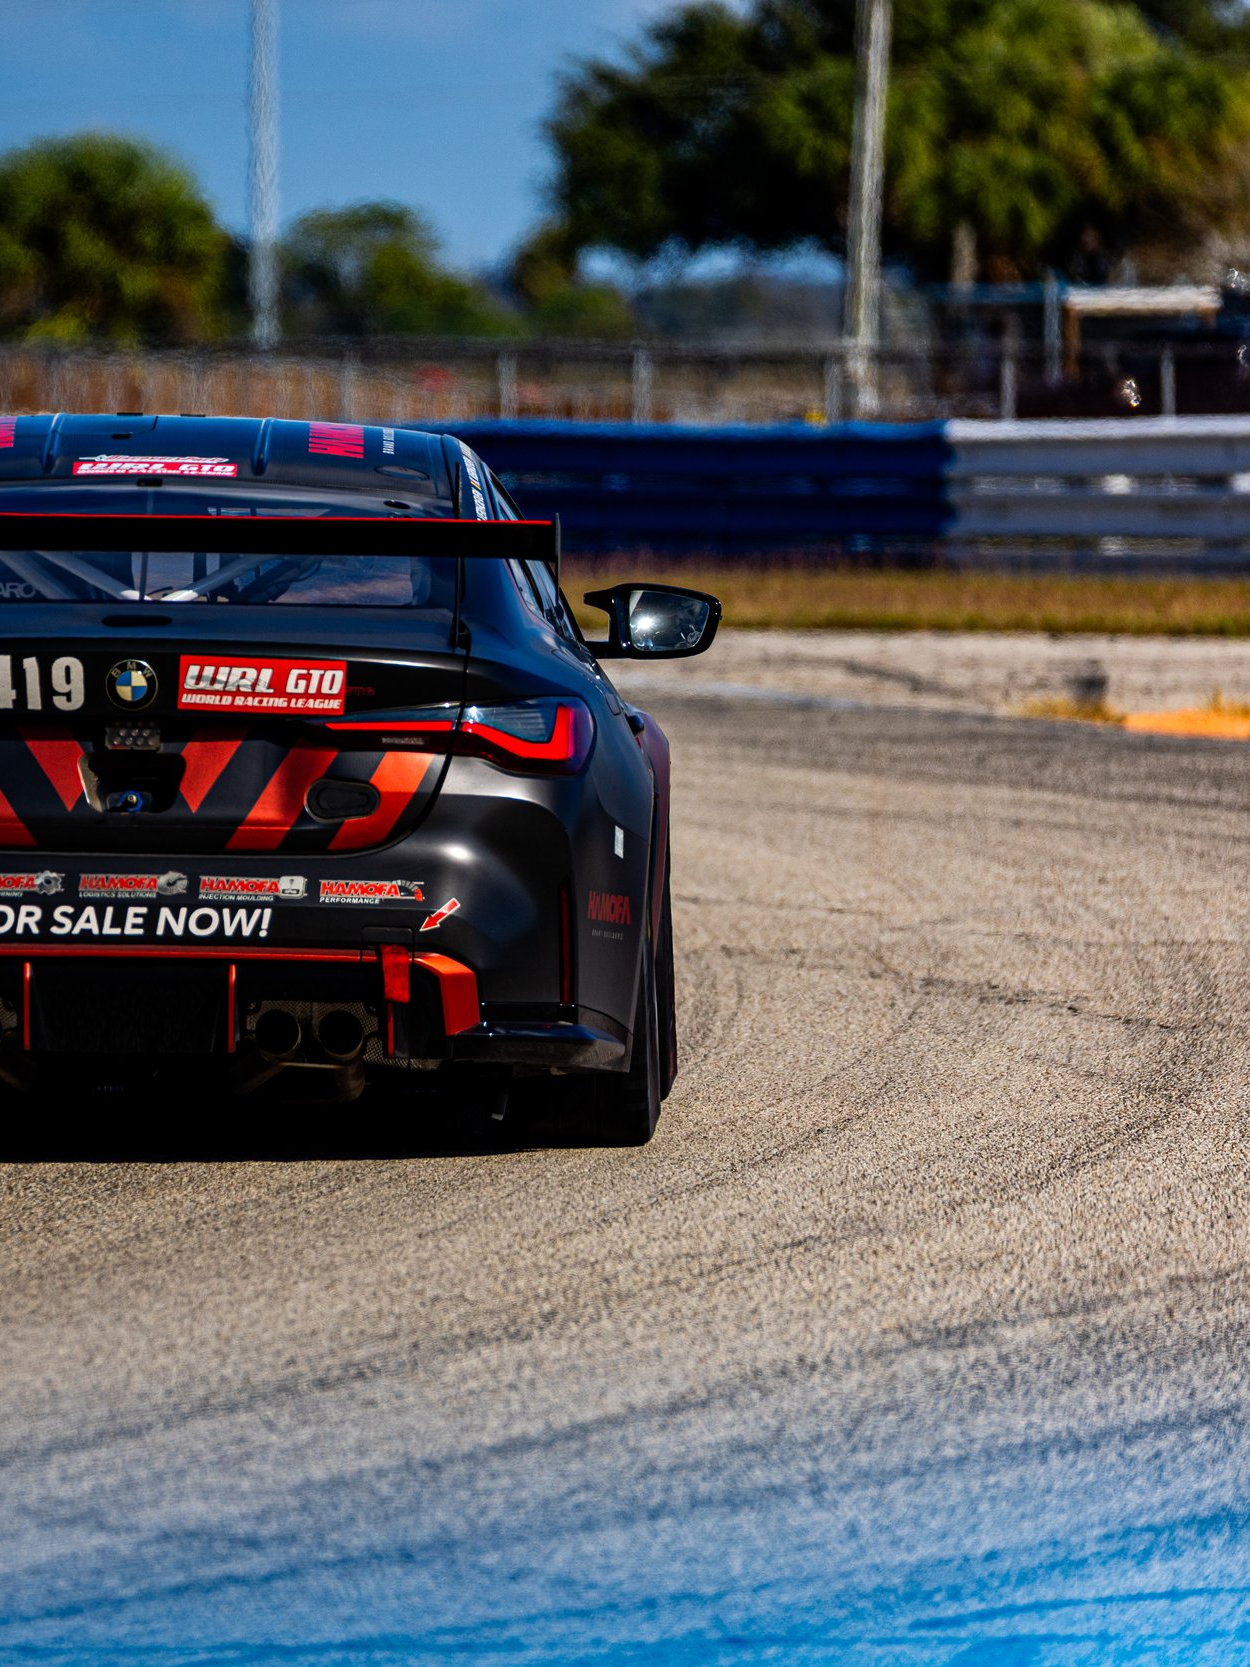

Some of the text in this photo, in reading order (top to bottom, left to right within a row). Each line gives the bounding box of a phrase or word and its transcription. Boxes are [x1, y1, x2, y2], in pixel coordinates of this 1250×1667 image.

[111, 661, 153, 678] BMW
[183, 664, 275, 693] WRL
[285, 668, 345, 695] GTO
[181, 693, 343, 710] WORLD RACING LEAGUE
[79, 876, 157, 890] HAMOFA
[199, 878, 279, 893] HAMOFA
[320, 881, 400, 896] HAMOFA
[319, 897, 380, 905] PERFORMANCE
[588, 891, 631, 924] HAMOFA
[50, 905, 146, 936] SALE
[156, 906, 272, 938] NOW!
